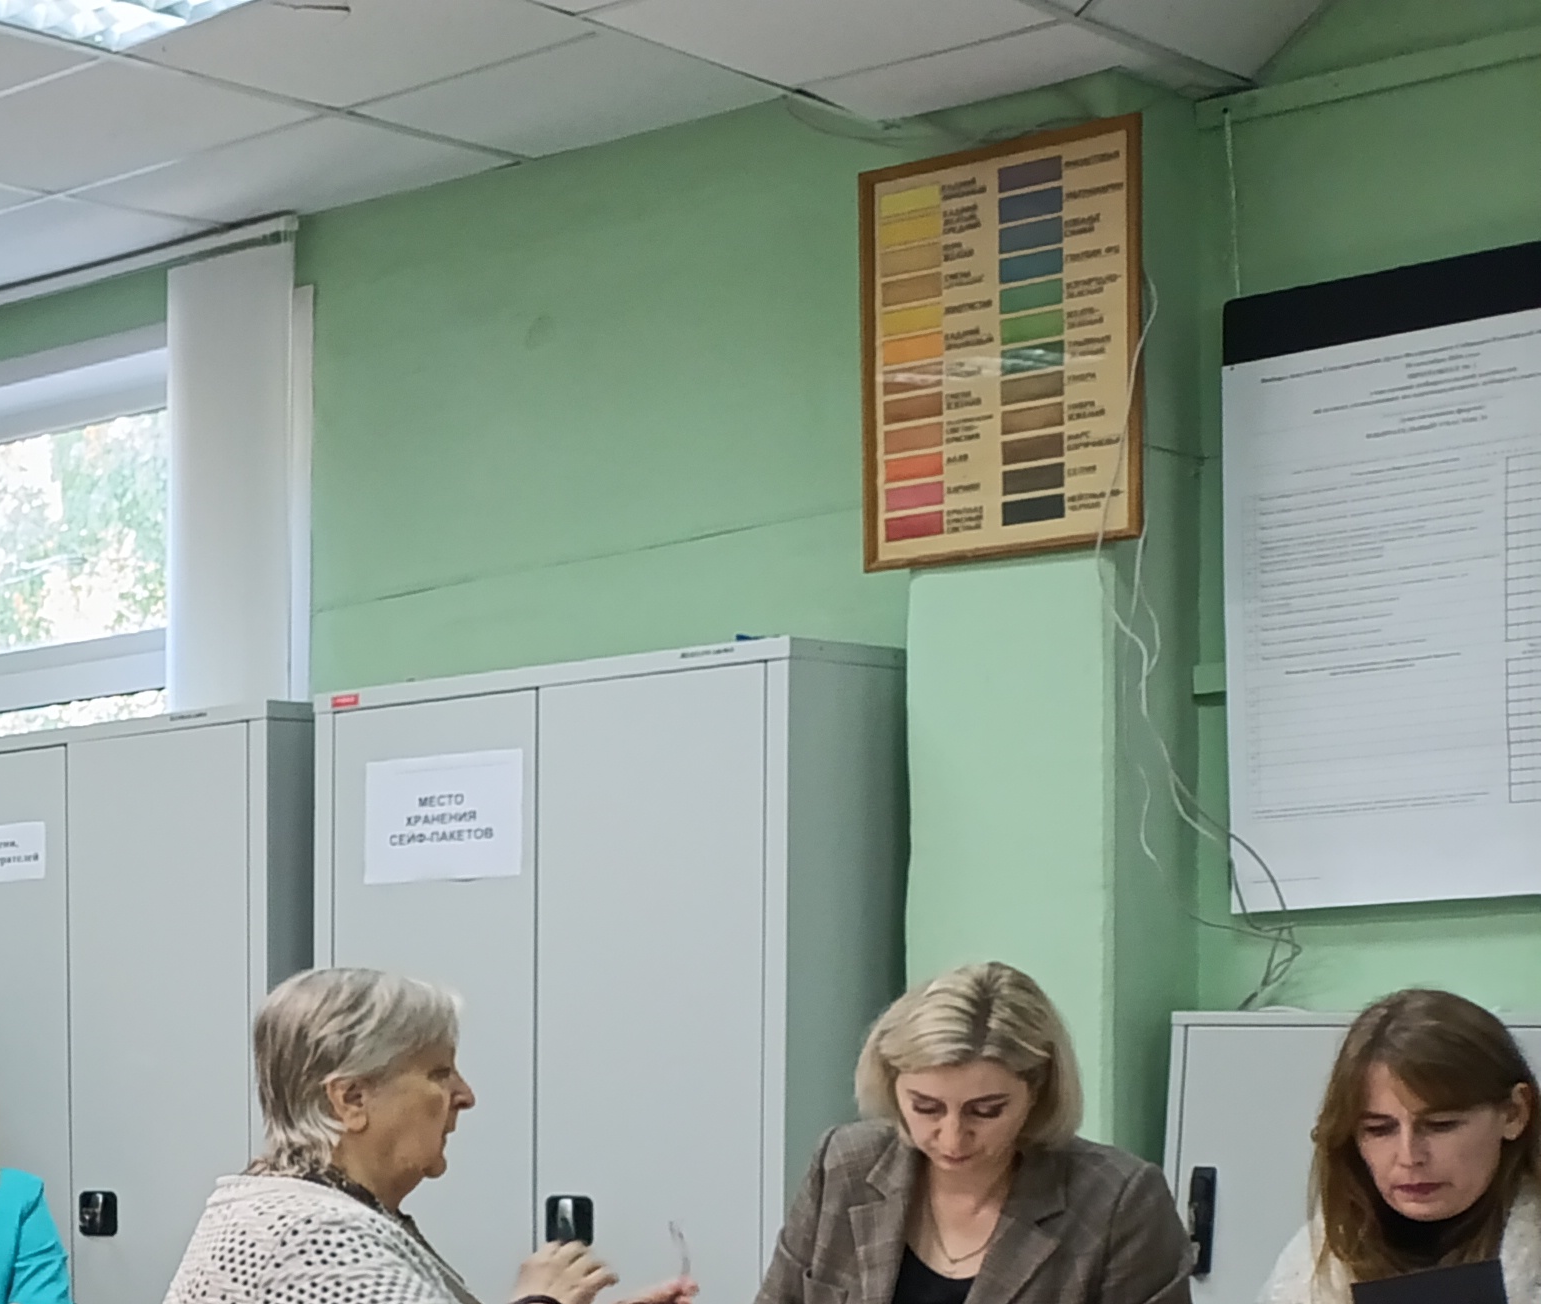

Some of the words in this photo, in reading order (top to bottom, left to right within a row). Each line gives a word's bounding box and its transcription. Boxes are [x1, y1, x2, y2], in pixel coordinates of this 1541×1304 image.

[418, 793, 465, 808] МЕСТО
[405, 810, 477, 827] ХРАНЕНИЯ
[389, 827, 494, 847] СЕЙФ-ПАКЕТОВ
